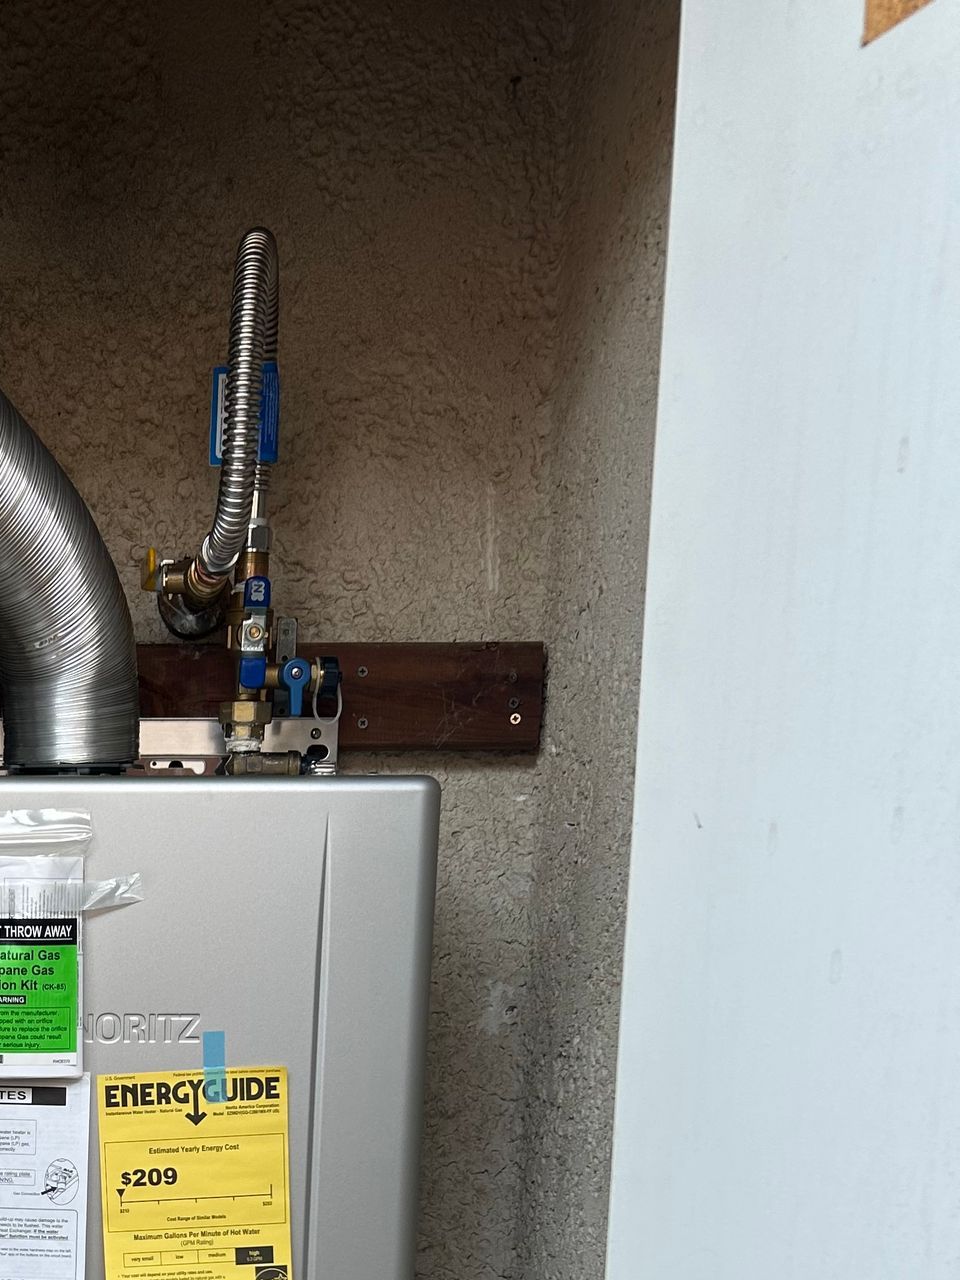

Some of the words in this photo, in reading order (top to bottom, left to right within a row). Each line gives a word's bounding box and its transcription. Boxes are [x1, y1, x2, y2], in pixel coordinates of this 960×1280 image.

[4, 925, 42, 937] THROW
[44, 925, 72, 937] AWAY
[38, 950, 60, 960] Gas
[32, 965, 54, 975] Gas
[21, 980, 38, 990] Kit
[181, 1146, 200, 1154] Yearly
[202, 1145, 223, 1153] Energy
[121, 1168, 178, 1187] $209
